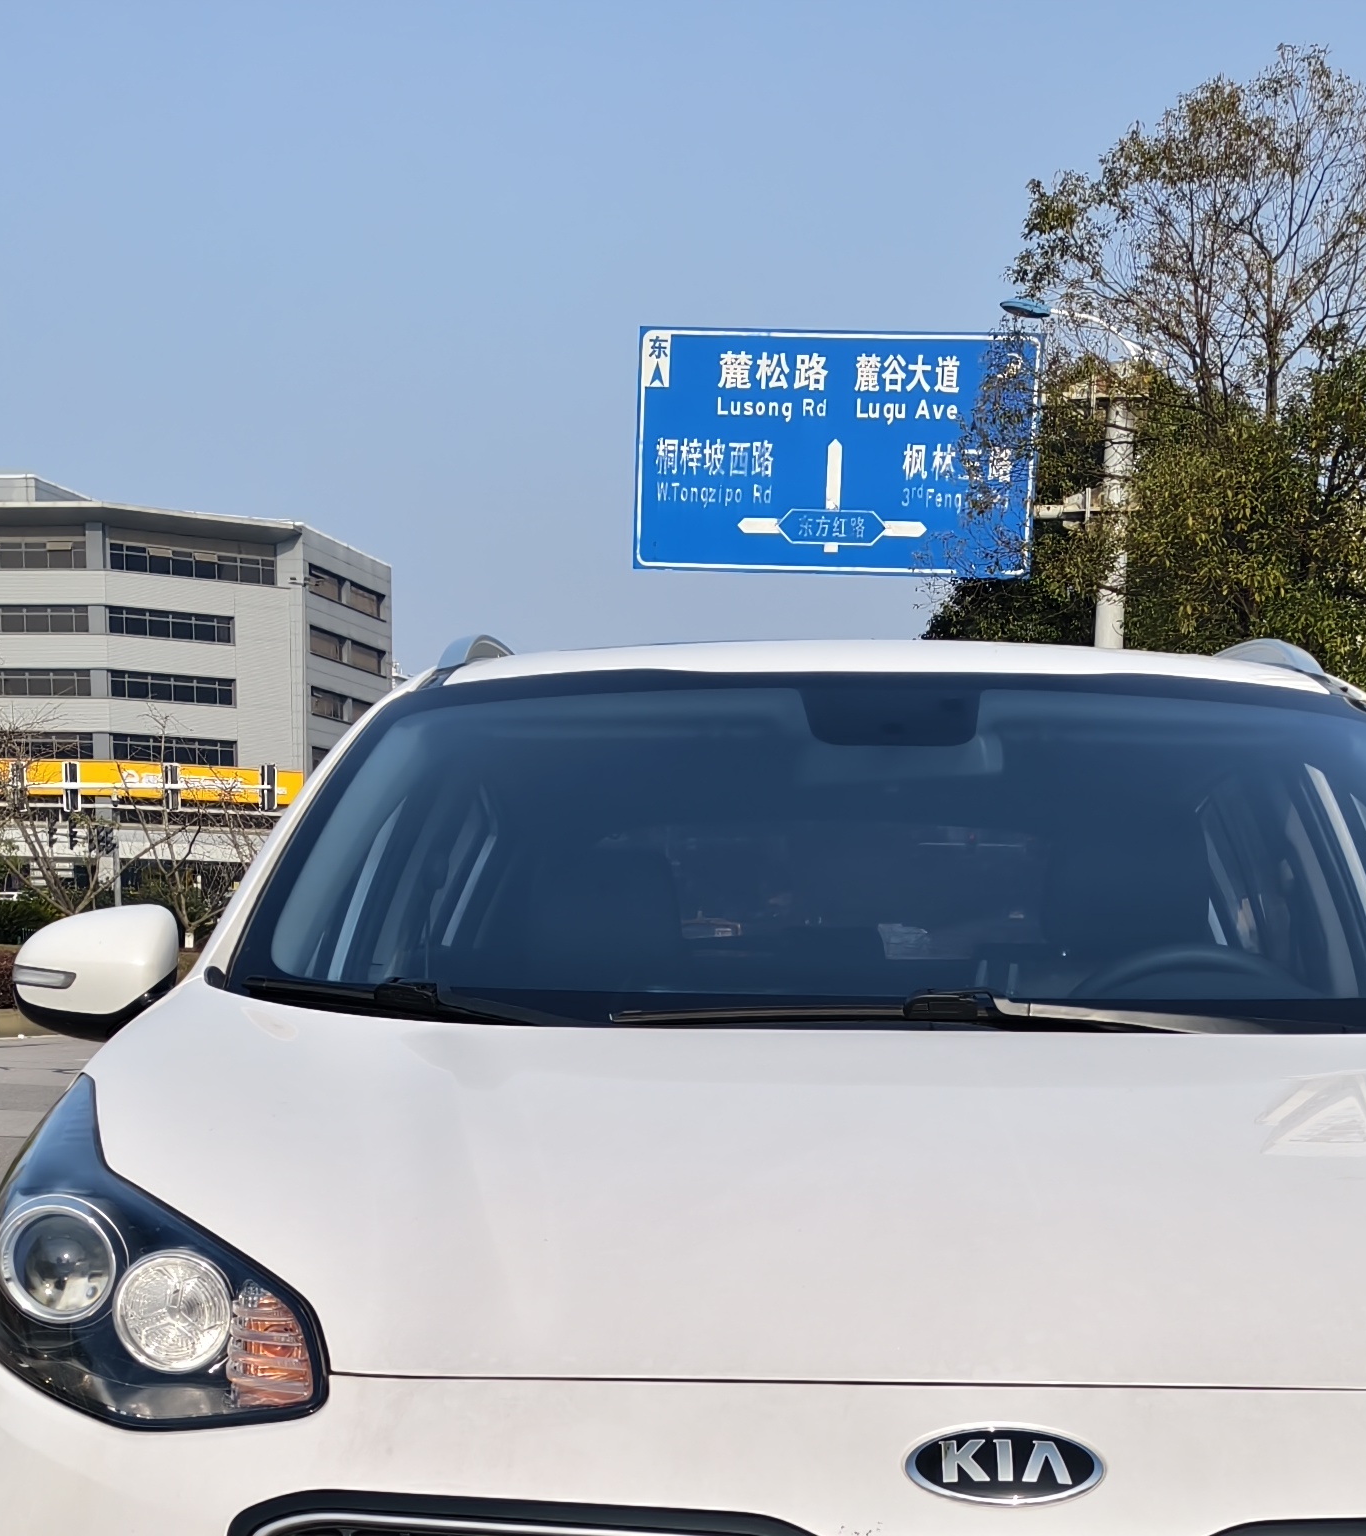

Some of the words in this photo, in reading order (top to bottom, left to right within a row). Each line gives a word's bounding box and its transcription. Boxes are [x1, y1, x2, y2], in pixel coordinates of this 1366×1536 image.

[648, 335, 669, 358] 东
[717, 351, 829, 392] 麓松路
[854, 353, 960, 394] 麓谷大道
[717, 396, 792, 423] Lusong
[802, 398, 827, 418] Rd
[856, 398, 907, 425] Lugu
[915, 399, 958, 420] Ave
[753, 483, 772, 504] Rd
[798, 514, 865, 538] 东方红路
[938, 1439, 1073, 1485] KIA
